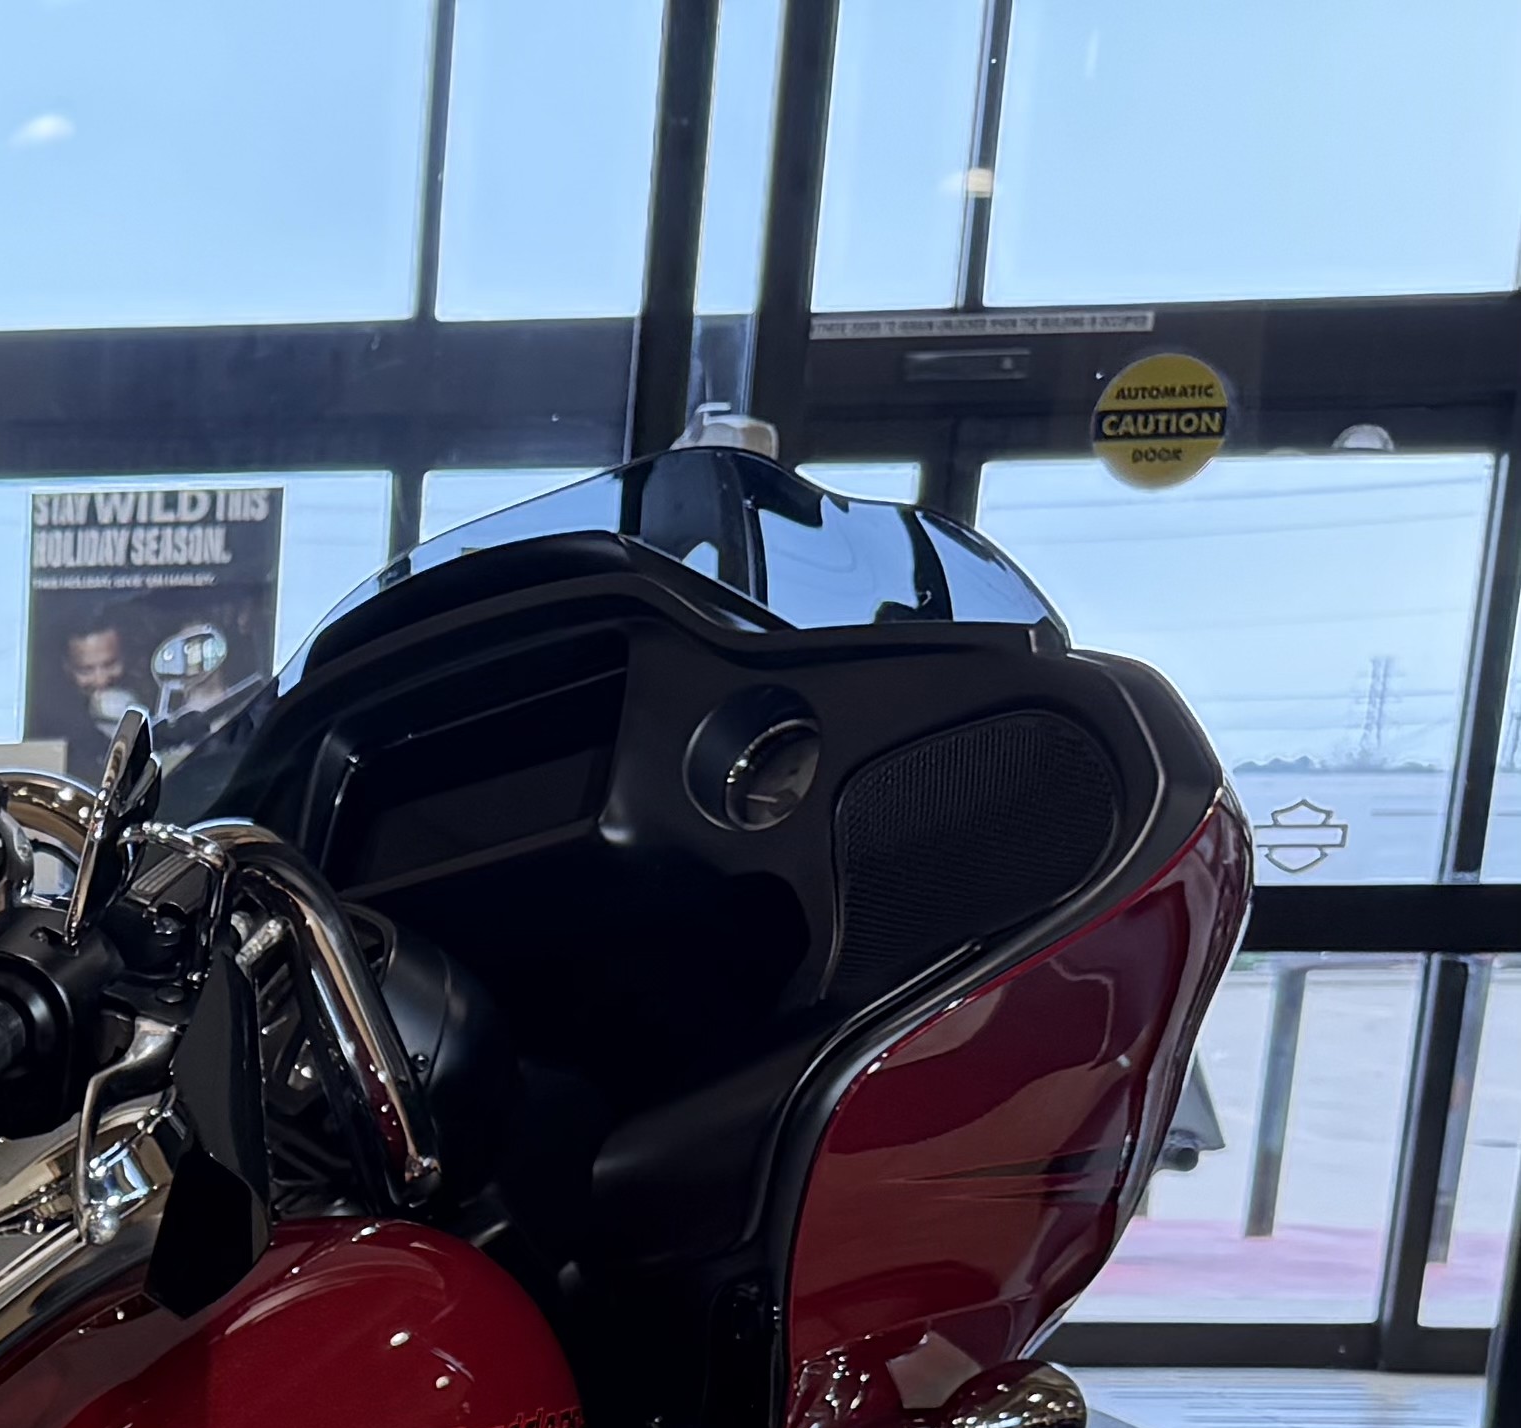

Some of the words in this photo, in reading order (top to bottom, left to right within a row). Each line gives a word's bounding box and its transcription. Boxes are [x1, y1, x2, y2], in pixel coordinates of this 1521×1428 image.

[1116, 383, 1215, 400] AUTOMATIC
[1101, 412, 1222, 436] CAUTION
[1131, 447, 1183, 463] DOOR
[33, 494, 90, 527] STAY
[93, 490, 211, 525] WILD
[214, 489, 270, 522] THIS
[32, 527, 131, 568] HOLIDAY
[130, 525, 234, 567] SEASON.
